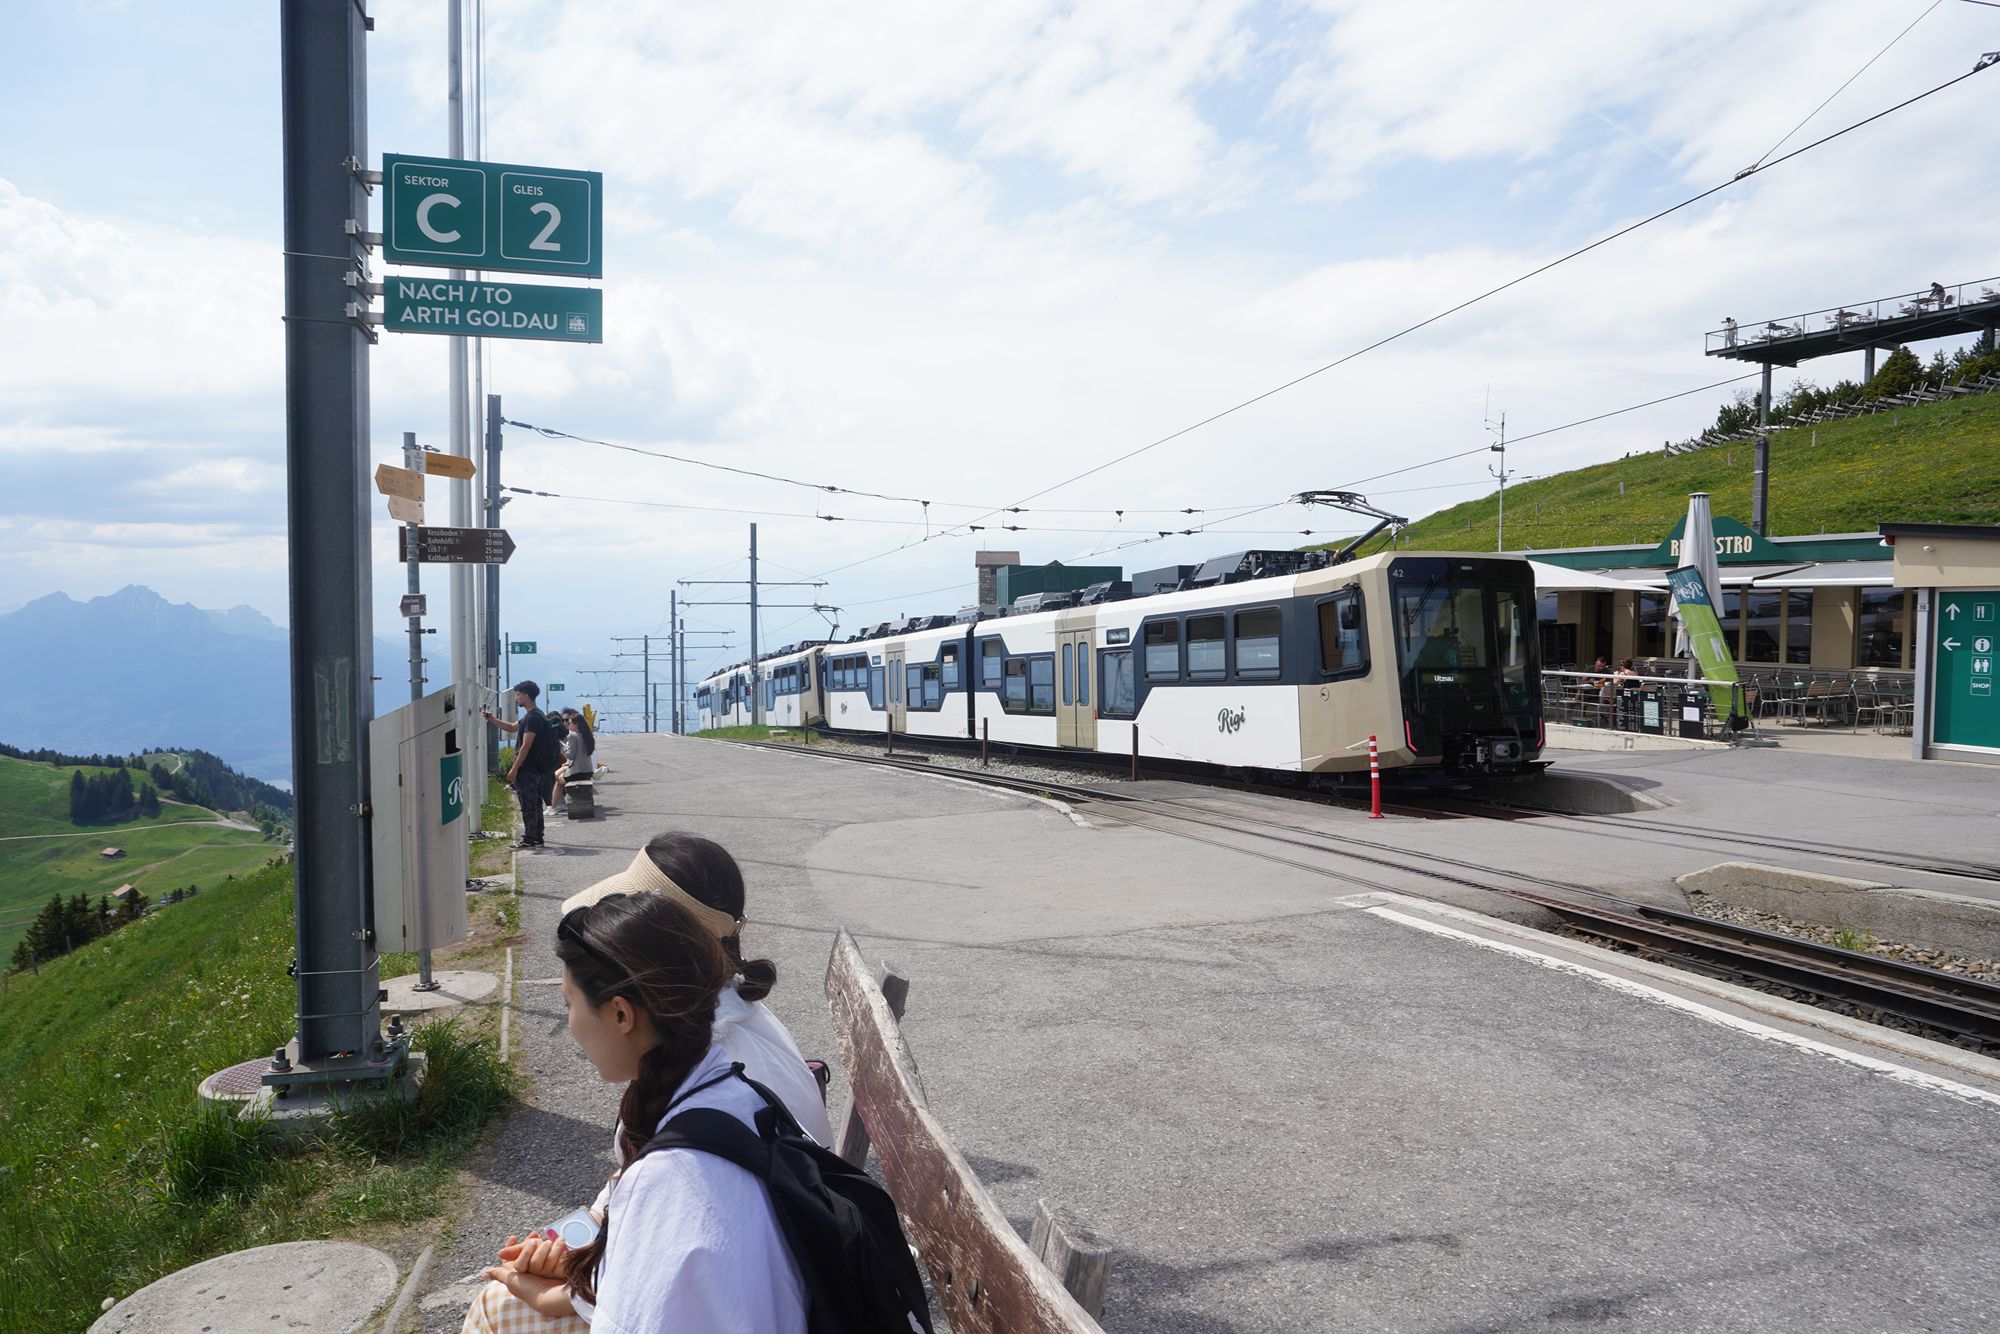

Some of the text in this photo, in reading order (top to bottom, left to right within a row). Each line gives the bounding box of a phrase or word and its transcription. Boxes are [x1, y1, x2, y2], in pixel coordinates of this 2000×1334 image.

[404, 175, 449, 188] SEKTOR
[513, 184, 543, 196] GLEIS
[416, 193, 462, 243] C
[529, 202, 561, 251] 2
[399, 282, 512, 305] NACH / TO
[400, 306, 558, 330] ARTH GOLDAU
[1713, 536, 1752, 554] STRO
[1392, 569, 1404, 578] 42
[1217, 705, 1246, 734] Rigi
